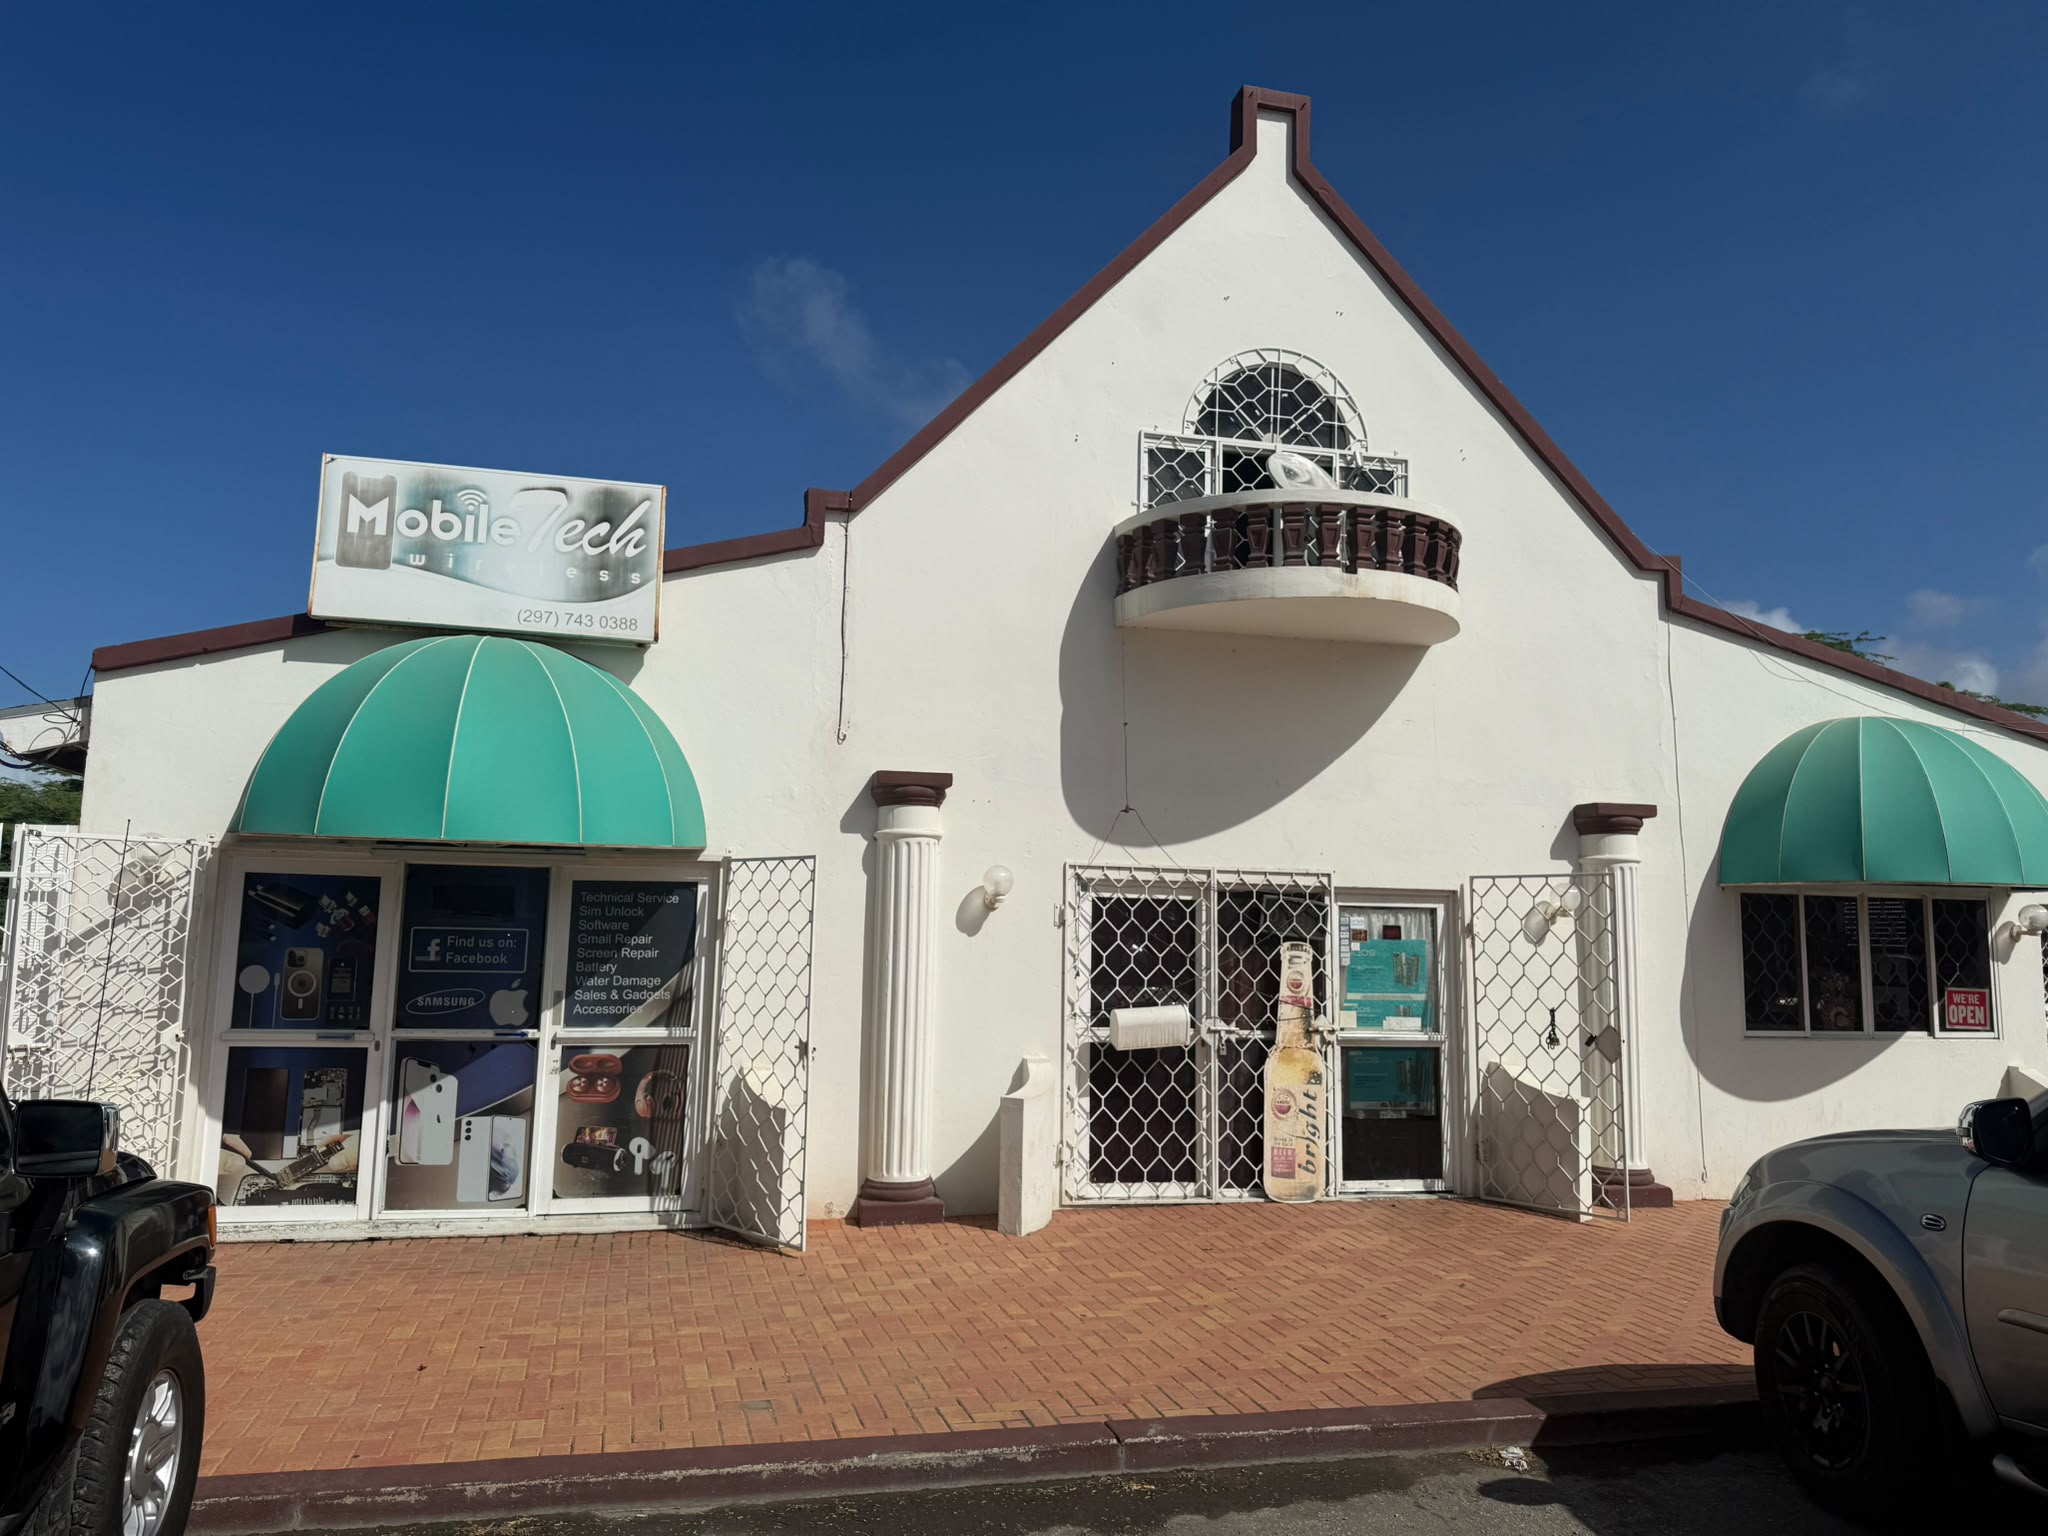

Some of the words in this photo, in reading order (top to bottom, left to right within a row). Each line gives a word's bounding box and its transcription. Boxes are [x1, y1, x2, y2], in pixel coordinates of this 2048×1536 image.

[517, 608, 560, 627] (297)
[565, 612, 594, 628] 743
[599, 615, 639, 631] 0388
[580, 891, 634, 903] Technical
[637, 892, 680, 904] Service
[579, 905, 602, 916] Sim
[605, 906, 645, 917] Unlock
[578, 919, 630, 931] Software
[447, 935, 475, 948] Find
[478, 938, 494, 948] us
[497, 938, 517, 949] on:
[577, 934, 612, 945] Gmail
[615, 933, 654, 947] Repair
[446, 951, 508, 964] Facebook
[576, 947, 618, 959] Screen
[621, 947, 660, 960] Repair
[575, 961, 618, 975] Battery
[575, 975, 610, 987] Water
[612, 975, 662, 988] Damage
[416, 996, 476, 1007] SAMSUNG
[574, 989, 607, 1001] Sales
[610, 989, 619, 1000] &
[1952, 992, 1980, 1005] WE'RE
[1948, 1004, 1985, 1025] OPEN
